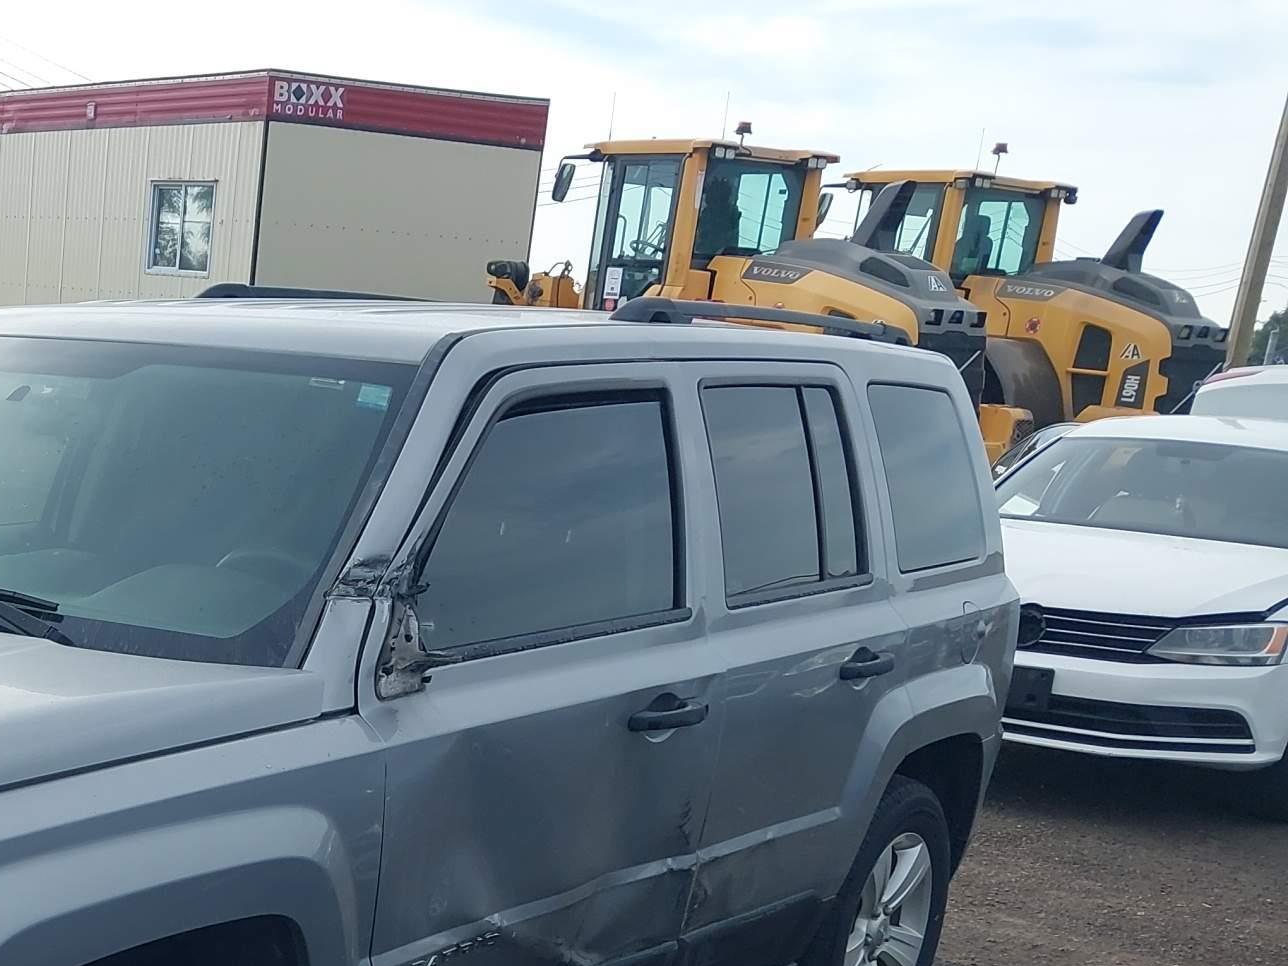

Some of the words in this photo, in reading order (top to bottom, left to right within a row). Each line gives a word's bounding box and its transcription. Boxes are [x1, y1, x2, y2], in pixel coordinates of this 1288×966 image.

[274, 80, 345, 108] BOXX
[273, 103, 343, 120] MODULAR
[753, 266, 801, 280] VOLVO
[1007, 284, 1055, 297] VOLVO
[1120, 375, 1141, 403] L90H
